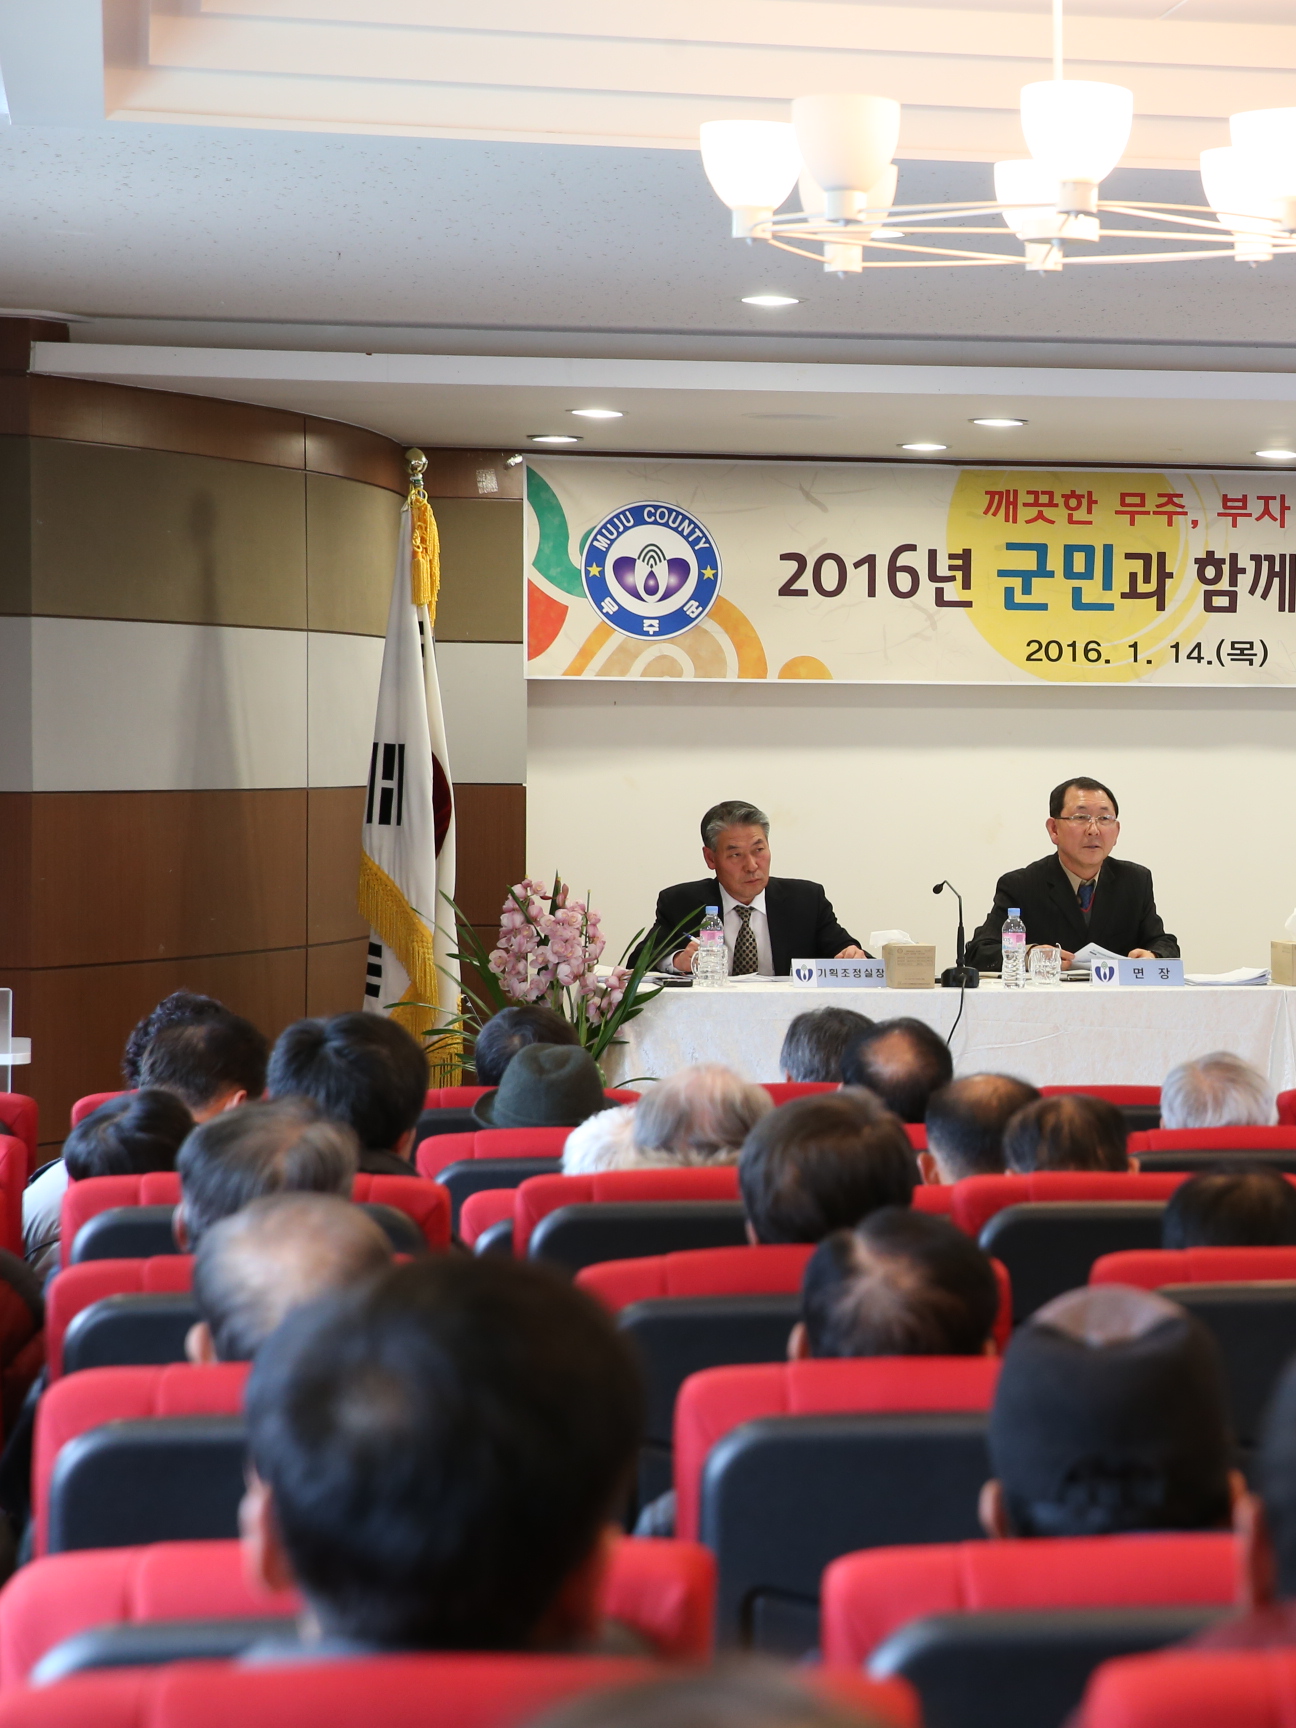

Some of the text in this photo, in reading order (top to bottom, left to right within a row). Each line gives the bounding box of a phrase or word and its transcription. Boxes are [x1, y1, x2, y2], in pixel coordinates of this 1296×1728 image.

[592, 506, 711, 552] MUJU COUNTY
[983, 489, 1098, 525] 깨끗한
[1115, 491, 1199, 529] 무주,
[1217, 493, 1291, 528] 부자
[778, 543, 973, 608] 2016년
[996, 541, 1174, 612] 군민과
[1025, 639, 1111, 664] 2016.
[1128, 641, 1153, 665] 1.
[817, 968, 885, 979] 기획조정실장
